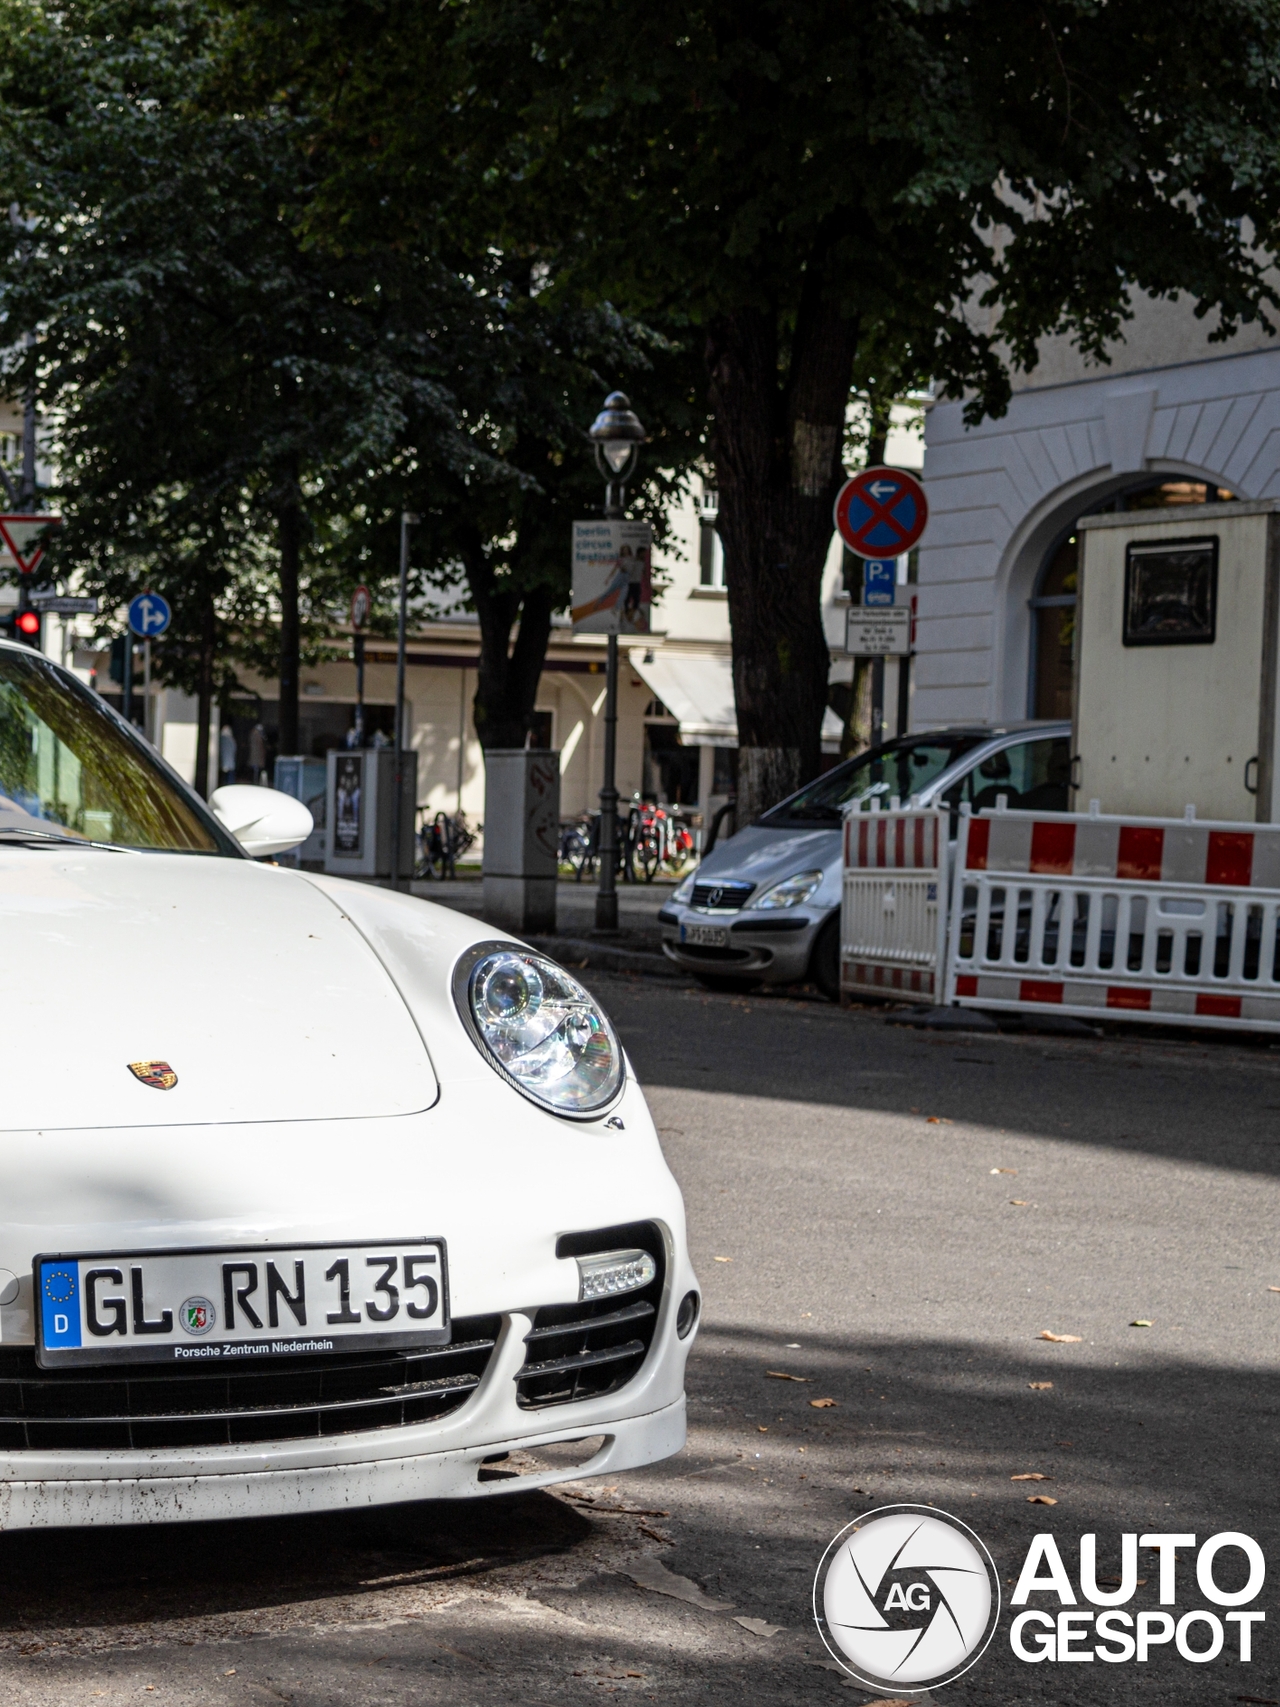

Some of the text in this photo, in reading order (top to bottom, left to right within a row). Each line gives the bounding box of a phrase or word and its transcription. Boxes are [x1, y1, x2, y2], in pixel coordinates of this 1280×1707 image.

[576, 526, 611, 537] berlin
[576, 540, 613, 550] circus
[869, 562, 883, 581] P
[54, 1253, 439, 1336] D GL RN 135
[174, 1339, 333, 1358] Porsche Zentrum Niederrhein
